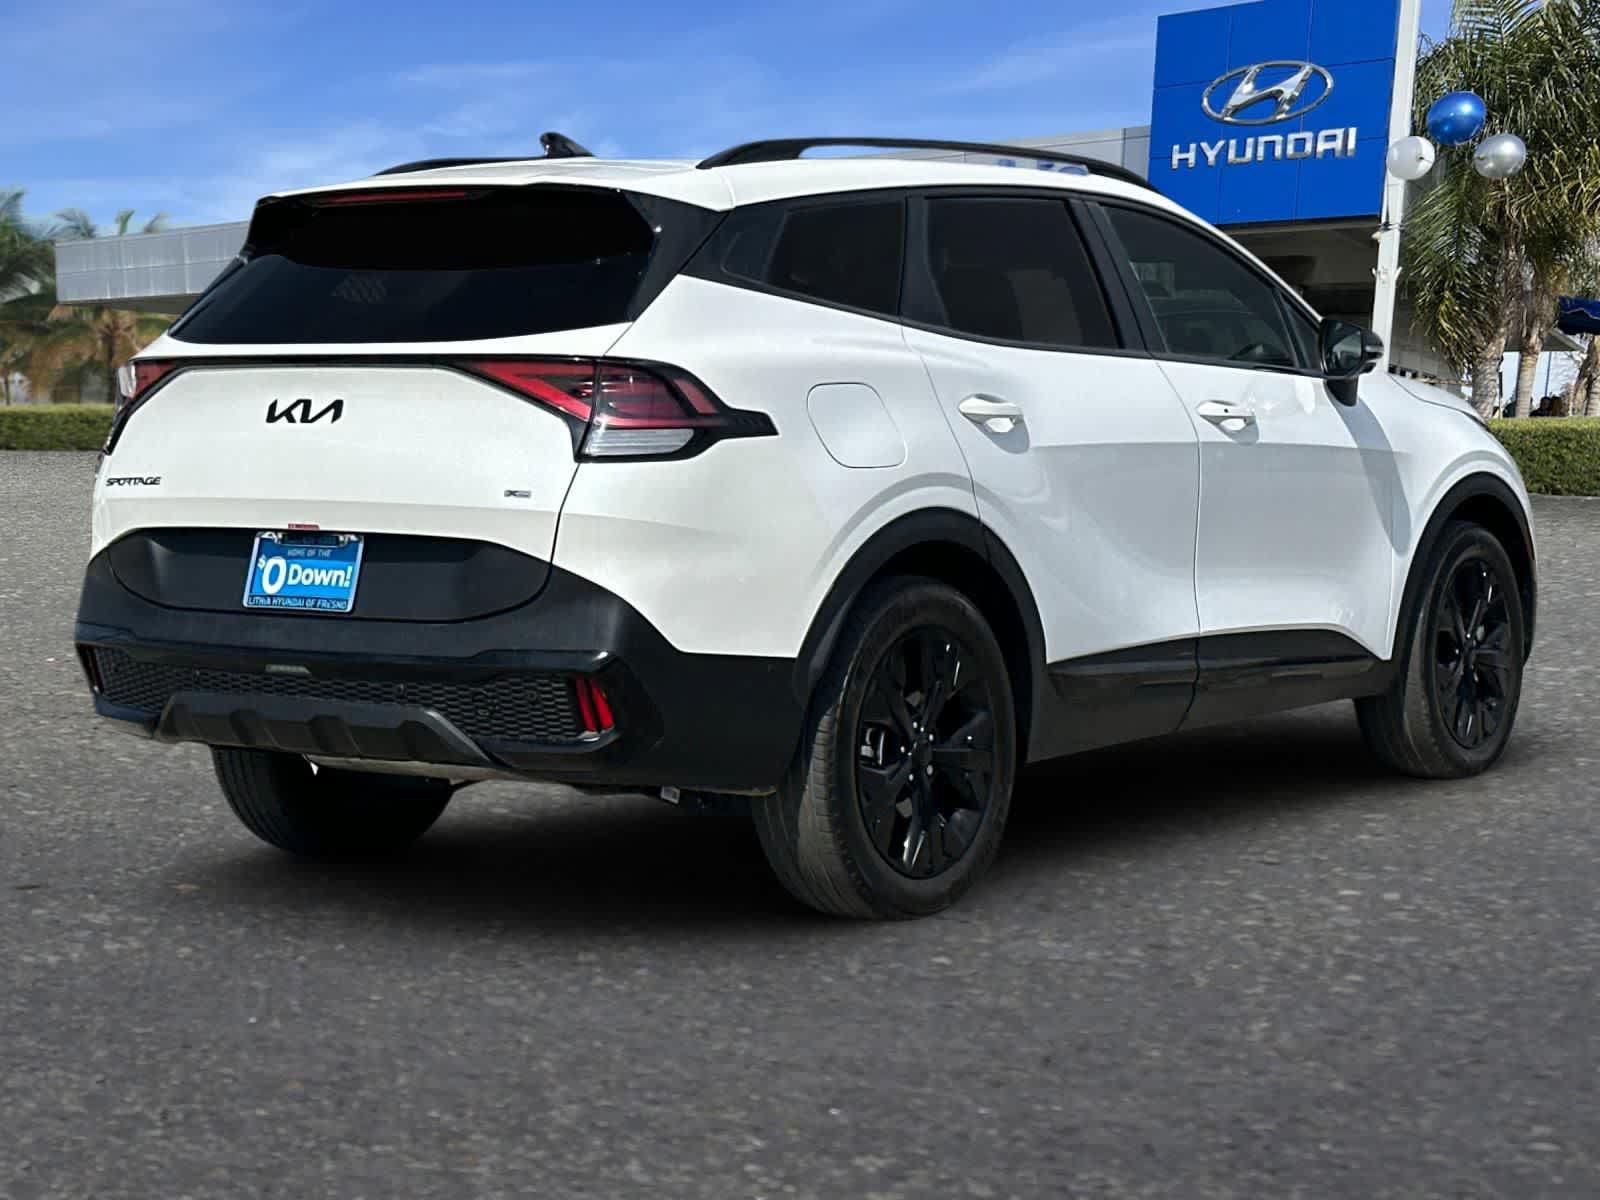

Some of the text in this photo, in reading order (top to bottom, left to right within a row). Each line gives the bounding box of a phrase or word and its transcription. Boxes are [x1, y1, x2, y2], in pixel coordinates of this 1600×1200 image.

[1171, 127, 1358, 170] HYUNDAI
[266, 398, 344, 424] KIA
[105, 476, 162, 487] SPORTAGE
[288, 548, 333, 558] HOME OF THE
[287, 563, 353, 588] Down!
[272, 597, 305, 608] HYUNDAI
[305, 598, 315, 608] OF
[316, 599, 347, 610] FRESNO
